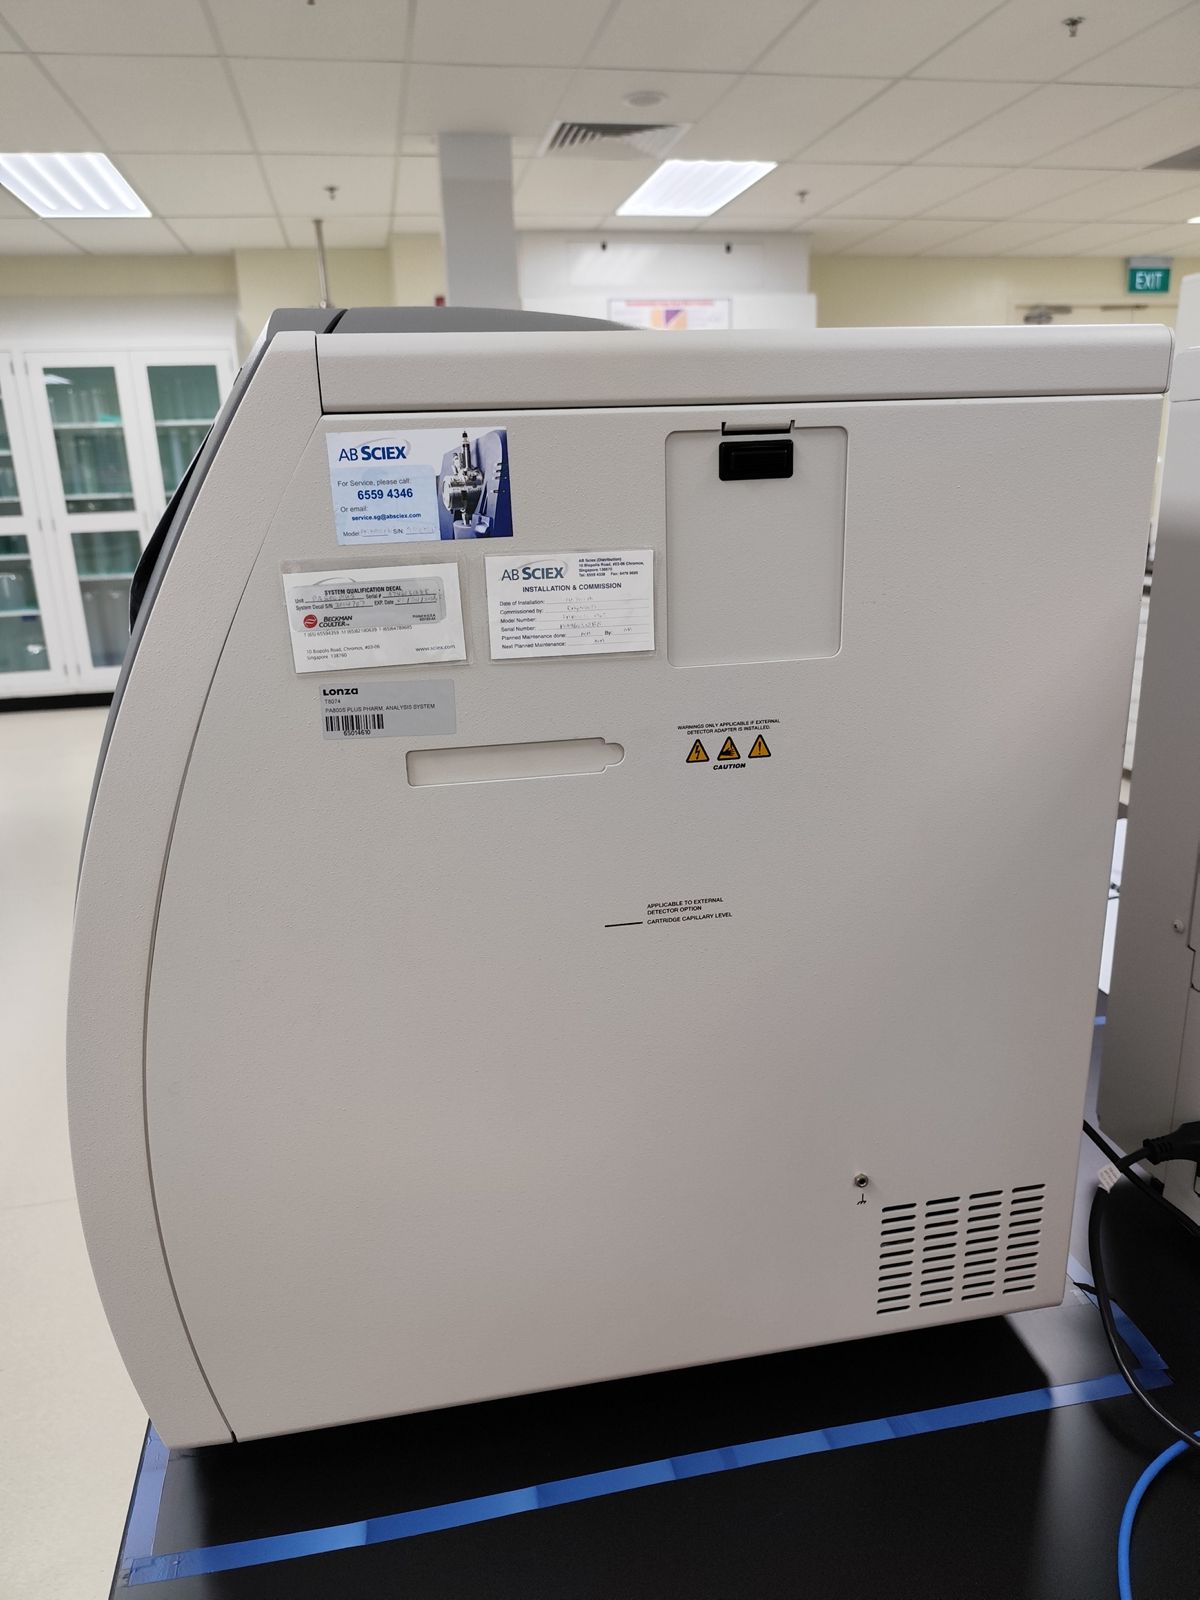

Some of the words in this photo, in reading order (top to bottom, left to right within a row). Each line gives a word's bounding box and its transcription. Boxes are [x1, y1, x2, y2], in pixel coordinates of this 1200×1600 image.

[1136, 271, 1162, 289] EXIT
[339, 449, 358, 462] AB
[362, 446, 406, 461] SCIEX
[358, 490, 383, 500] 6559
[387, 488, 413, 498] 4346
[501, 569, 519, 581] AB
[522, 567, 564, 580] SCIEX
[323, 688, 358, 696] Lonza
